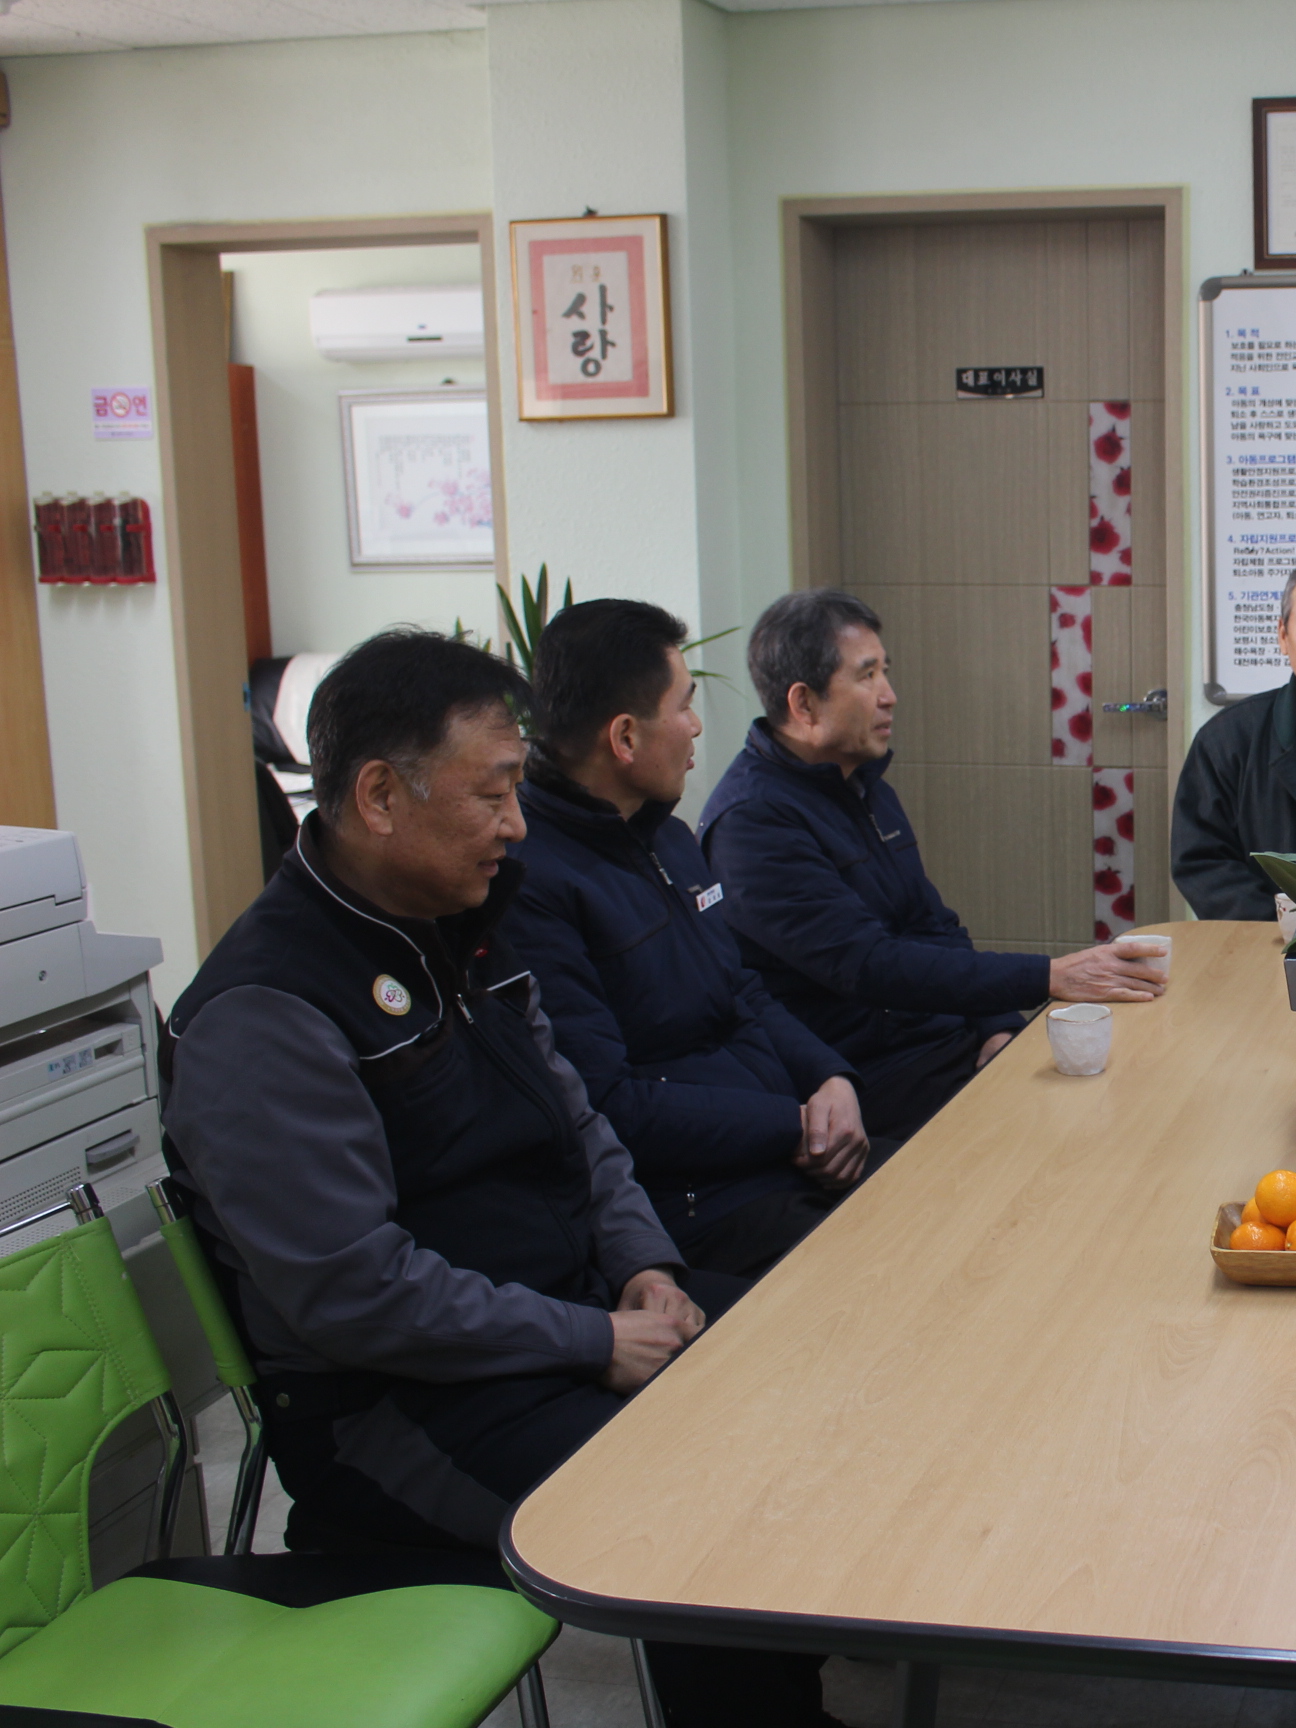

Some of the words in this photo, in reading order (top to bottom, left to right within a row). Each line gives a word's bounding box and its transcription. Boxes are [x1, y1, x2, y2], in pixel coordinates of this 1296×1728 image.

[561, 283, 617, 378] 사랑
[961, 369, 1037, 387] 대표이사실
[1239, 455, 1296, 464] 아동프로그램
